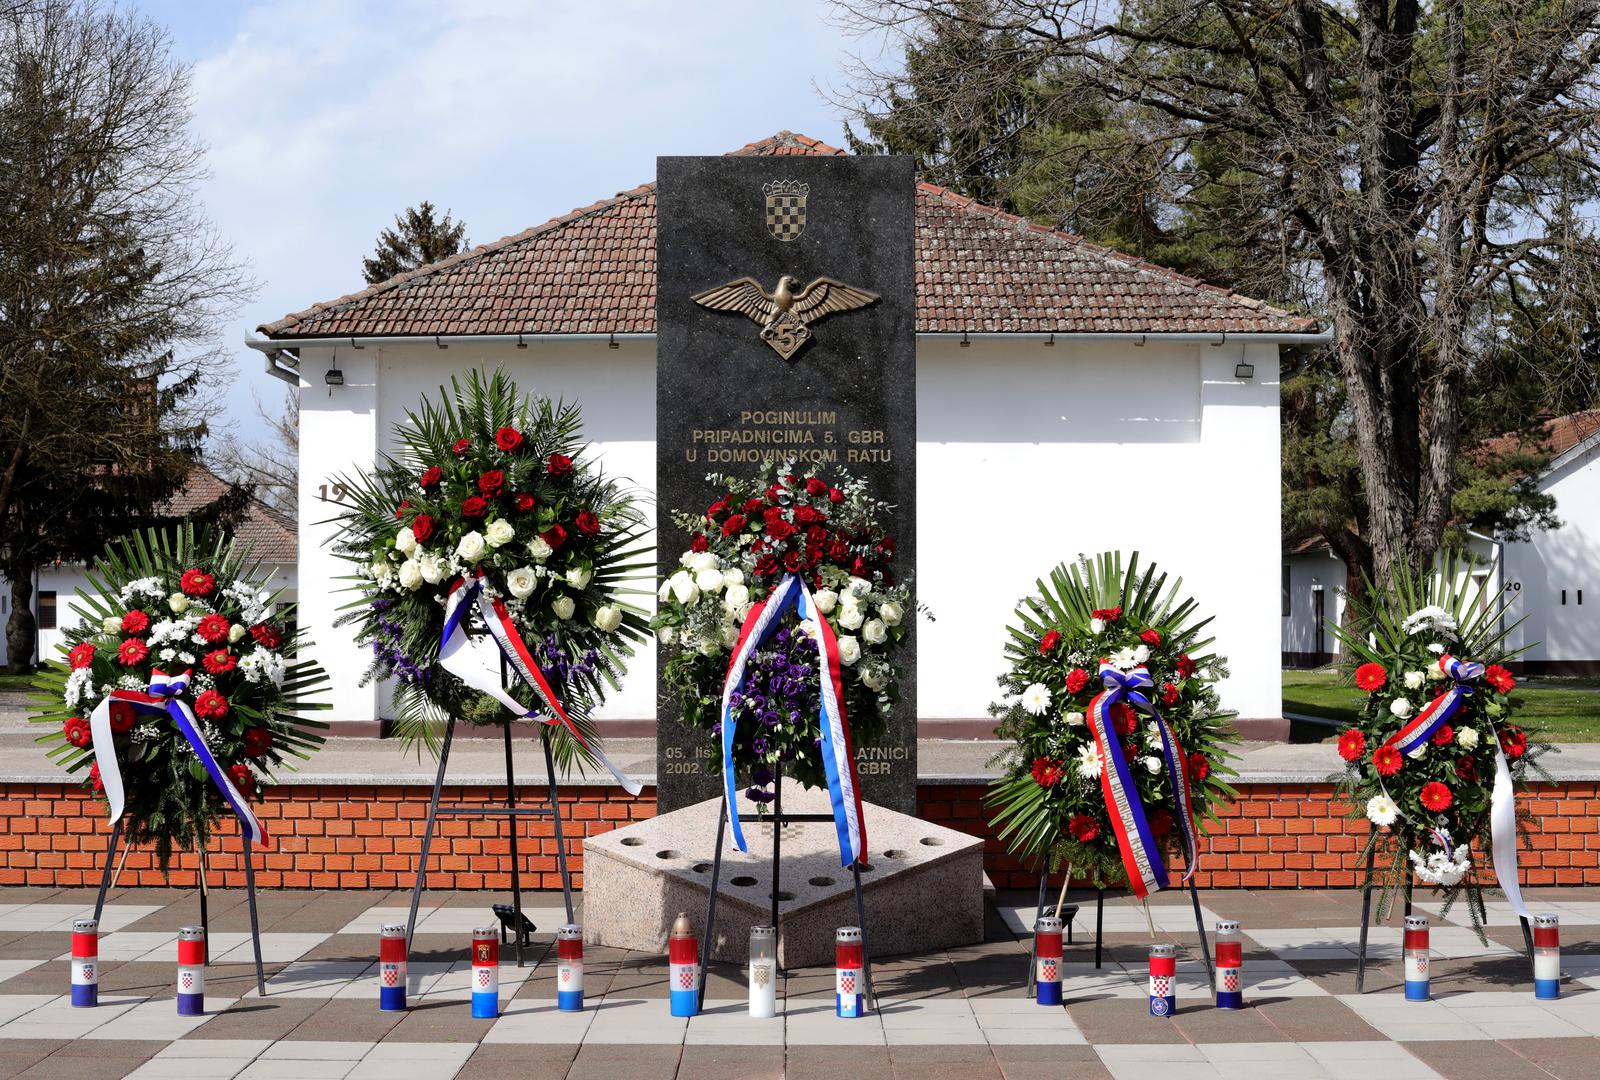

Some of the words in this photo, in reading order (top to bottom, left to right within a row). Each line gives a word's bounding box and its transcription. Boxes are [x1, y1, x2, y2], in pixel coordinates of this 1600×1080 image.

[741, 411, 836, 425] POGINULIM
[693, 430, 815, 444] PRIPADNICIMA
[824, 430, 838, 444] 5.
[849, 430, 884, 444] GBR
[686, 450, 697, 463] U
[708, 449, 837, 463] DOMOVINSKOM
[848, 449, 891, 463] RATU
[318, 483, 348, 502] 19
[1504, 582, 1521, 592] 20
[666, 747, 687, 759] 05.
[666, 762, 703, 774] 2002.
[857, 761, 891, 775] GBR
